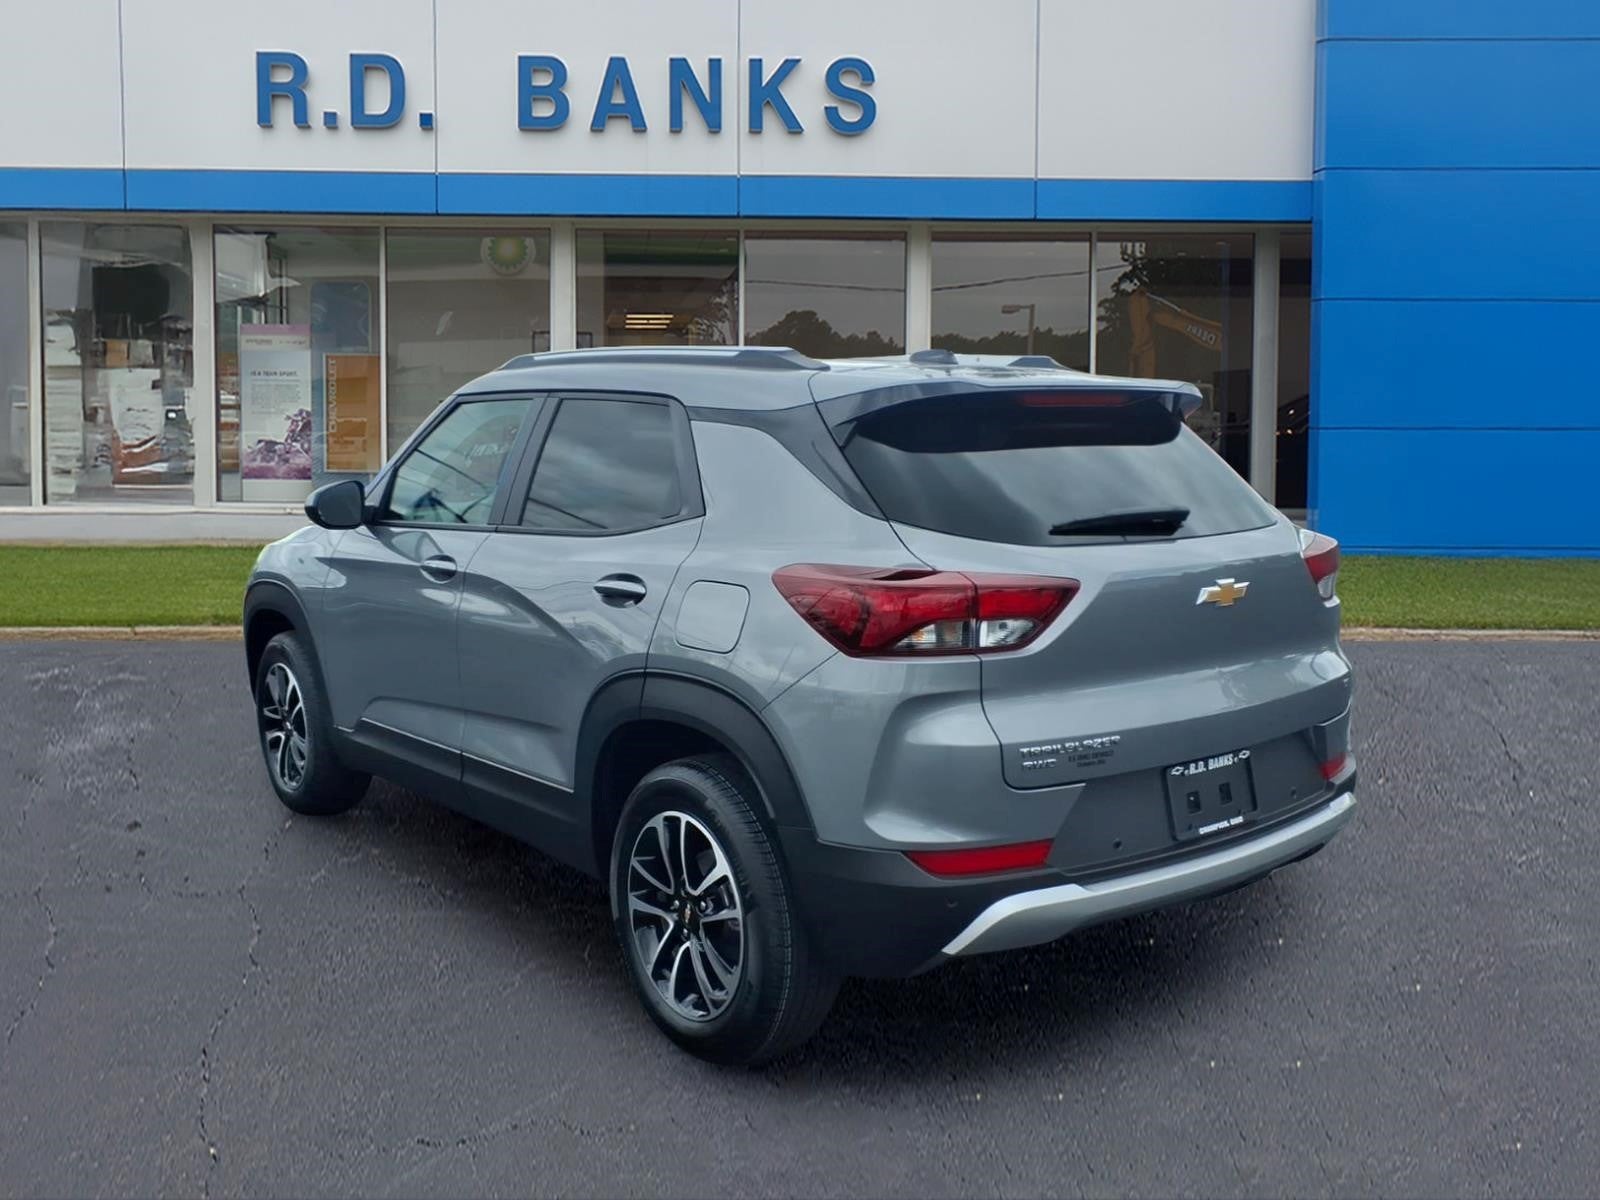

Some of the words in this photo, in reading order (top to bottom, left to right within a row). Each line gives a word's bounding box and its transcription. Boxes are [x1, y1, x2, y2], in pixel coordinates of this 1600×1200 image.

[256, 50, 434, 129] R.D.
[517, 55, 877, 135] BANKS
[328, 359, 337, 433] CHEVROLET
[1208, 753, 1234, 770] BANKS
